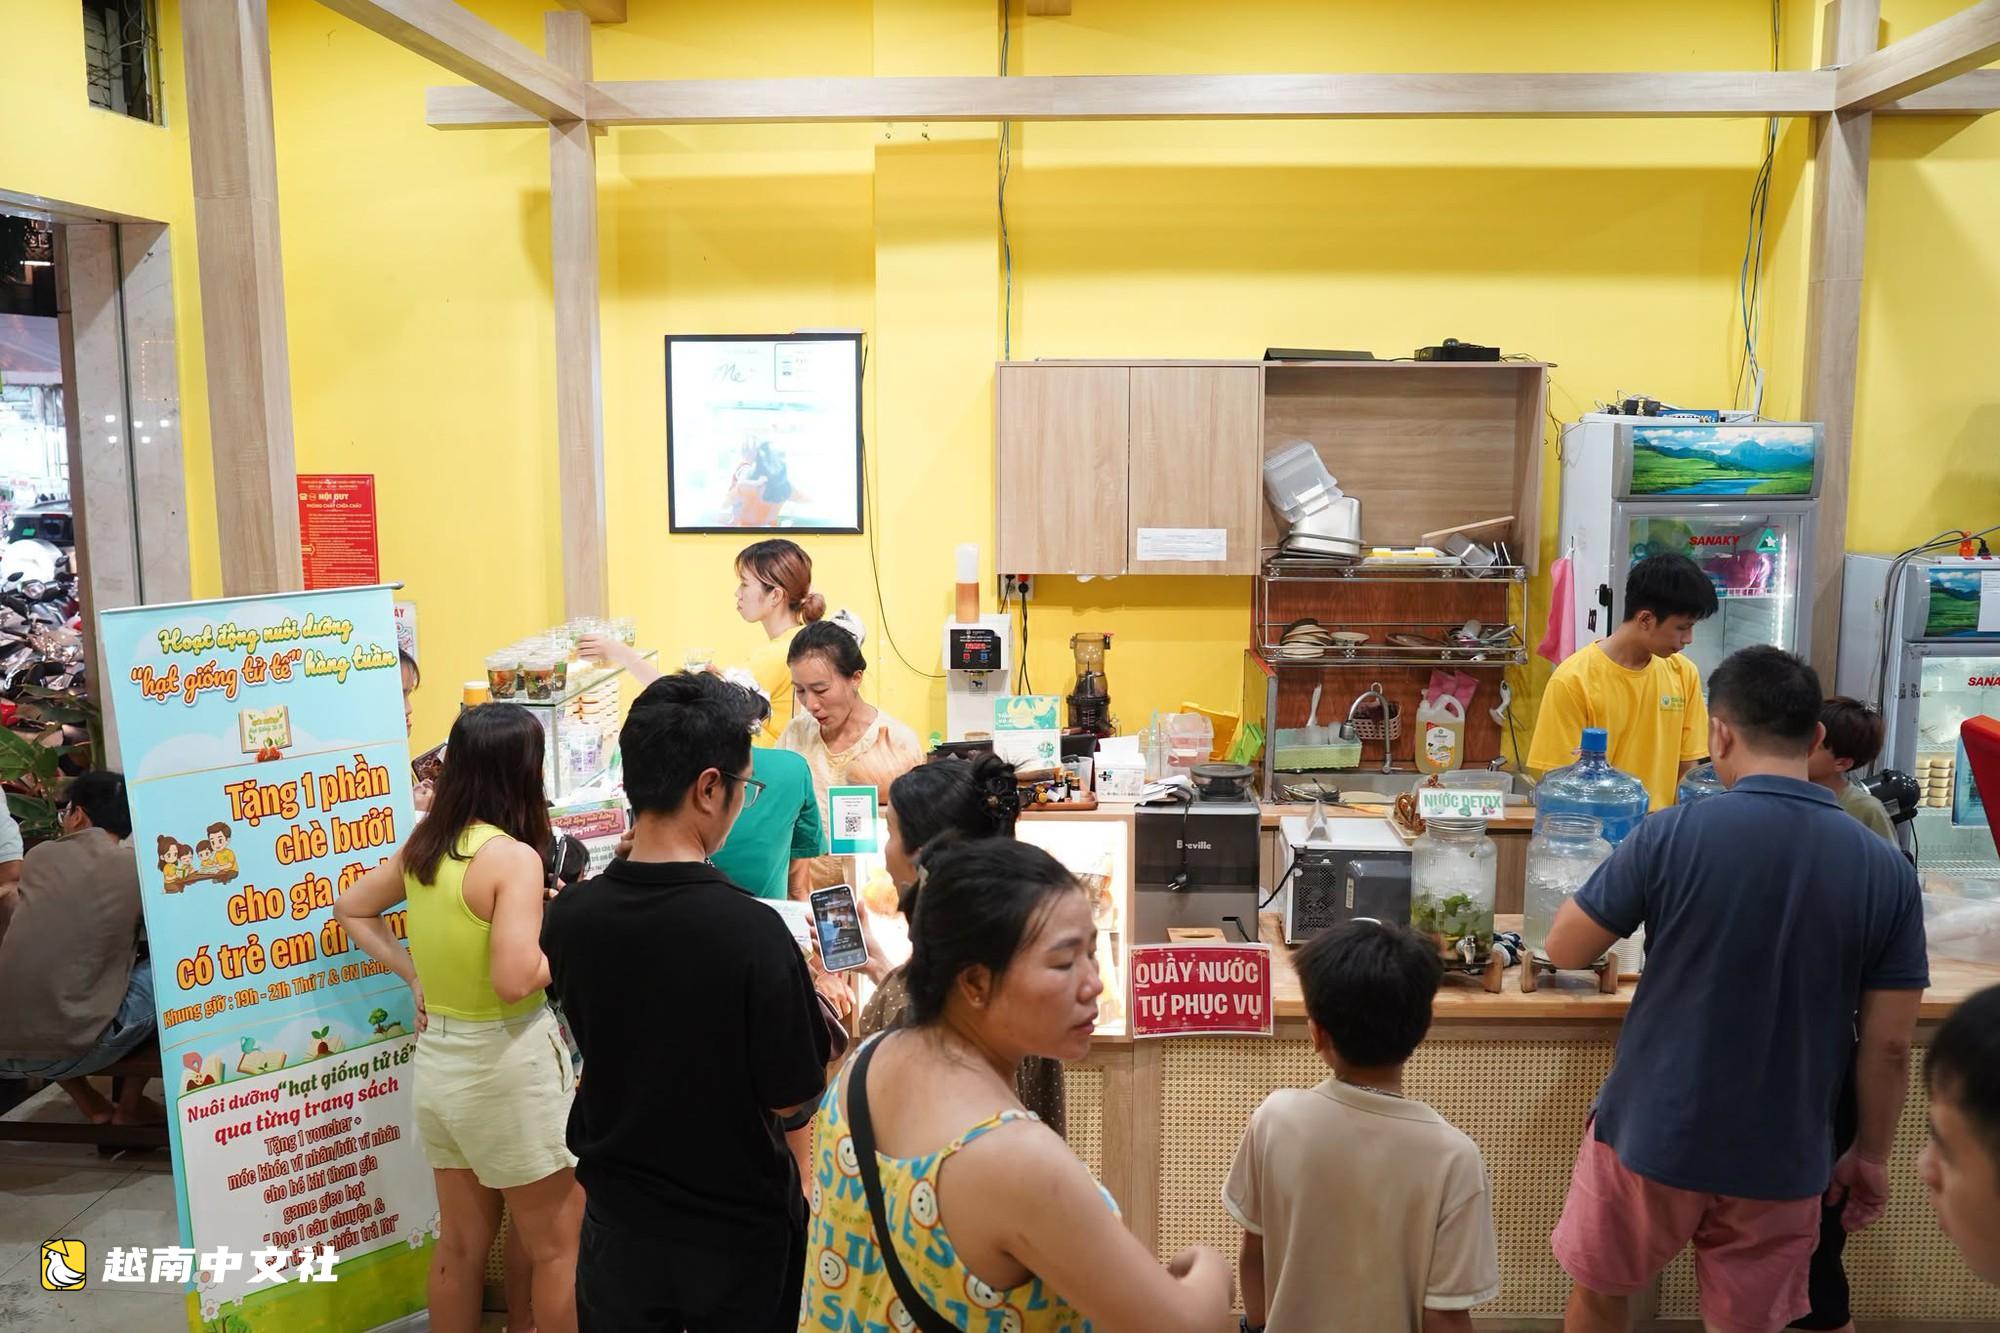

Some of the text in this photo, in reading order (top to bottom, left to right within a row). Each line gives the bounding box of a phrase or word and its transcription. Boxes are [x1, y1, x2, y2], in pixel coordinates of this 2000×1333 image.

[1689, 535, 1740, 546] SANAKY
[158, 612, 353, 656] Hoạt động nuôi dưỡng
[131, 643, 397, 704] “hạt giống tử tế” hàng tuần
[224, 753, 391, 827] Tặng 1 phần
[1462, 794, 1502, 809] DETOX
[275, 806, 396, 865] chè bưởi
[228, 884, 285, 926] cho
[290, 872, 334, 920] gia
[177, 945, 214, 990] có
[218, 933, 266, 979] trẻ
[271, 930, 317, 969] em
[1135, 952, 1259, 988] QUẦY NƯỚC
[163, 1003, 203, 1030] Khung
[204, 994, 226, 1019] giờ
[234, 988, 259, 1008] 19h
[268, 981, 291, 1001] 21h
[292, 974, 317, 995] Thứ
[316, 971, 326, 988] 7
[328, 968, 340, 986] &
[341, 963, 360, 982] CN
[1138, 992, 1262, 1021] TỰ PHỤC VỤ
[187, 1098, 224, 1123] Nuôi
[229, 1088, 279, 1110] dưỡng
[321, 1060, 369, 1090] giống
[373, 1051, 391, 1072] tử
[215, 1076, 399, 1146] qua từng trang sách
[257, 1159, 289, 1182] khóa
[371, 1125, 401, 1147] nhân
[264, 1134, 297, 1156] Tặng
[297, 1129, 304, 1147] 1
[305, 1117, 352, 1144] voucher
[264, 1154, 378, 1204] cho bé khi tham gia
[283, 1181, 366, 1225] game gieo hạt
[297, 1224, 304, 1240] 1
[306, 1218, 329, 1238] câu
[330, 1202, 372, 1231] chuyện
[374, 1197, 385, 1215] &
[360, 1221, 379, 1241] trả
